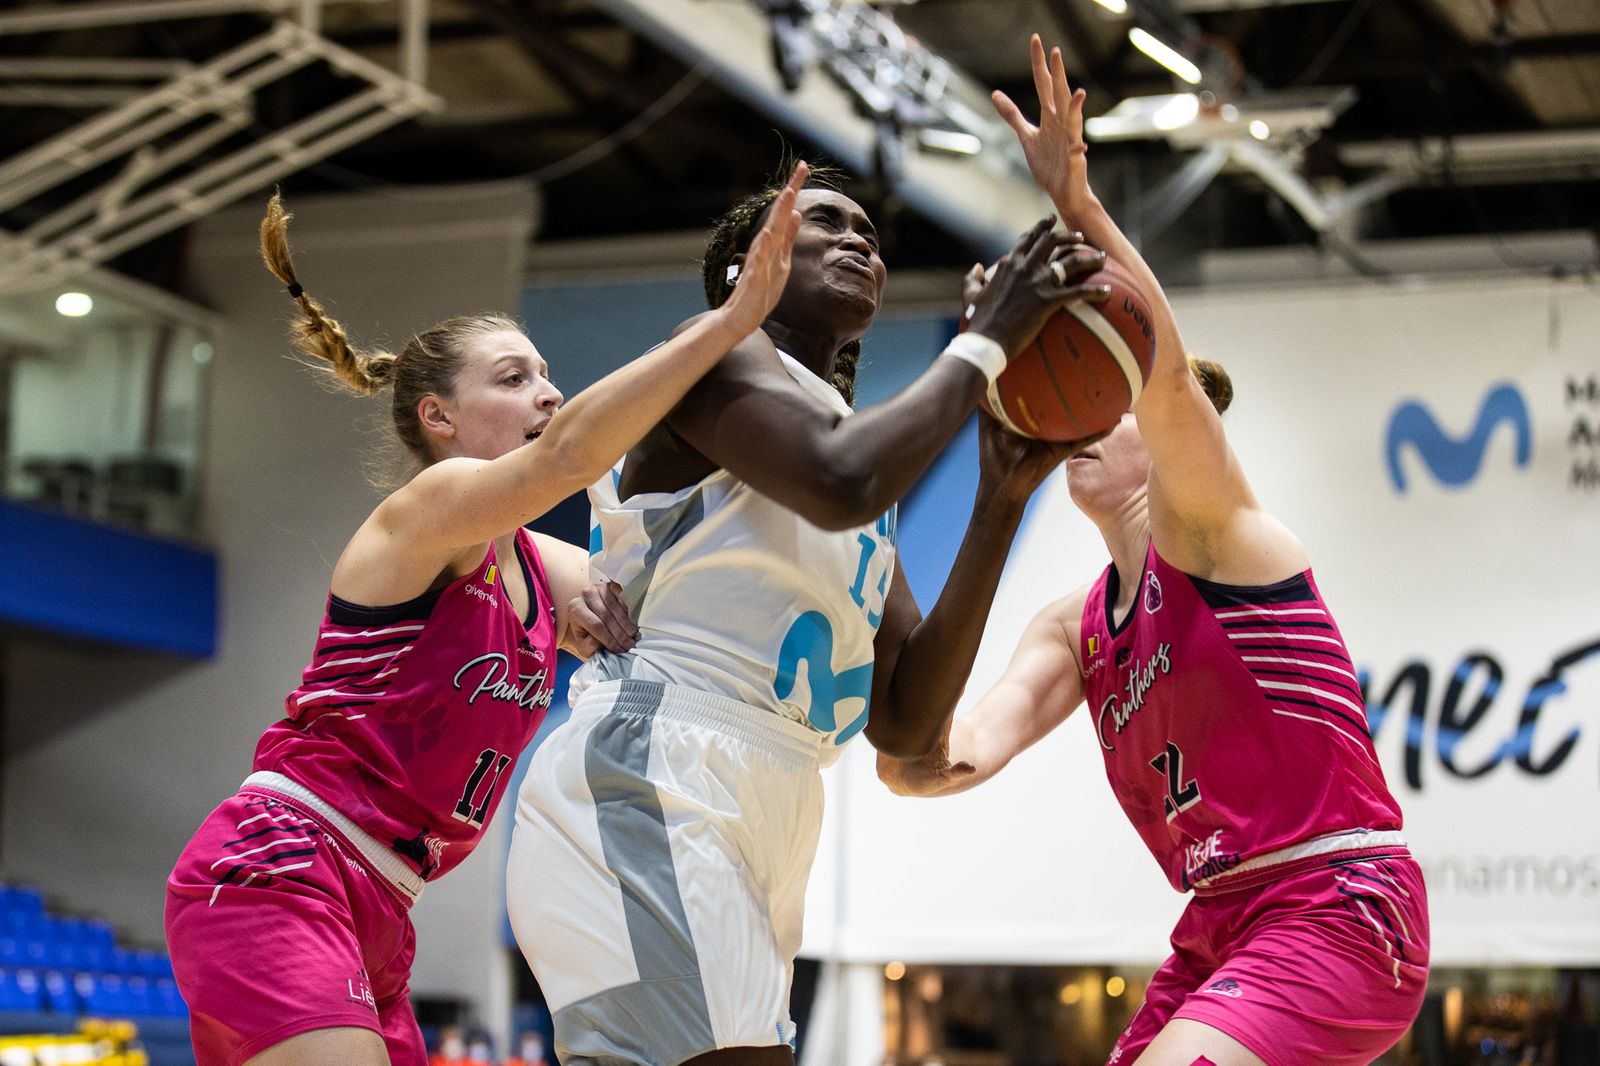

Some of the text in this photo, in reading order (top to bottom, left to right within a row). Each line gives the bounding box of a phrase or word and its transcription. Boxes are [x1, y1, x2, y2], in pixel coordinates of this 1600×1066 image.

[451, 748, 511, 830] 11
[1424, 855, 1600, 898] namos
[347, 976, 377, 1008] Liè
